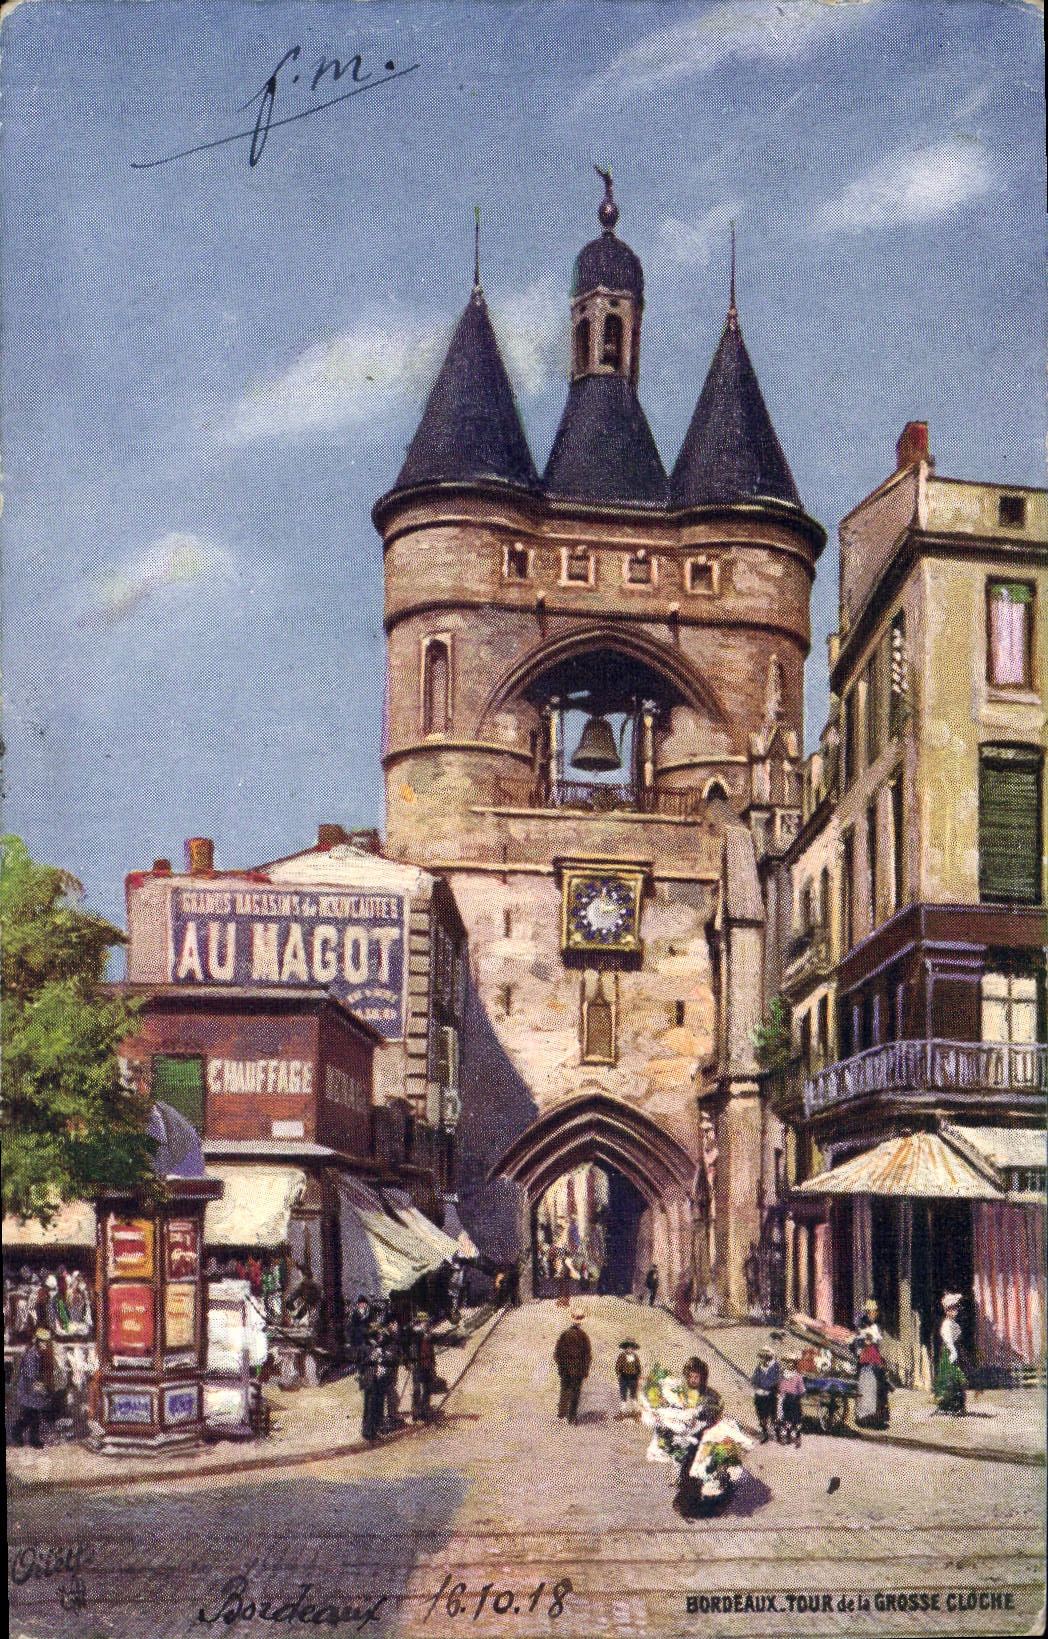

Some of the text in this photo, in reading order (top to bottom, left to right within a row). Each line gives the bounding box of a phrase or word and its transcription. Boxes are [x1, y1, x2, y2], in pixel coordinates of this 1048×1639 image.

[177, 921, 400, 985] AU MAGOT
[207, 1059, 313, 1093] CHAUFFAGE
[197, 1573, 573, 1631] Bordeaux 16.10.18
